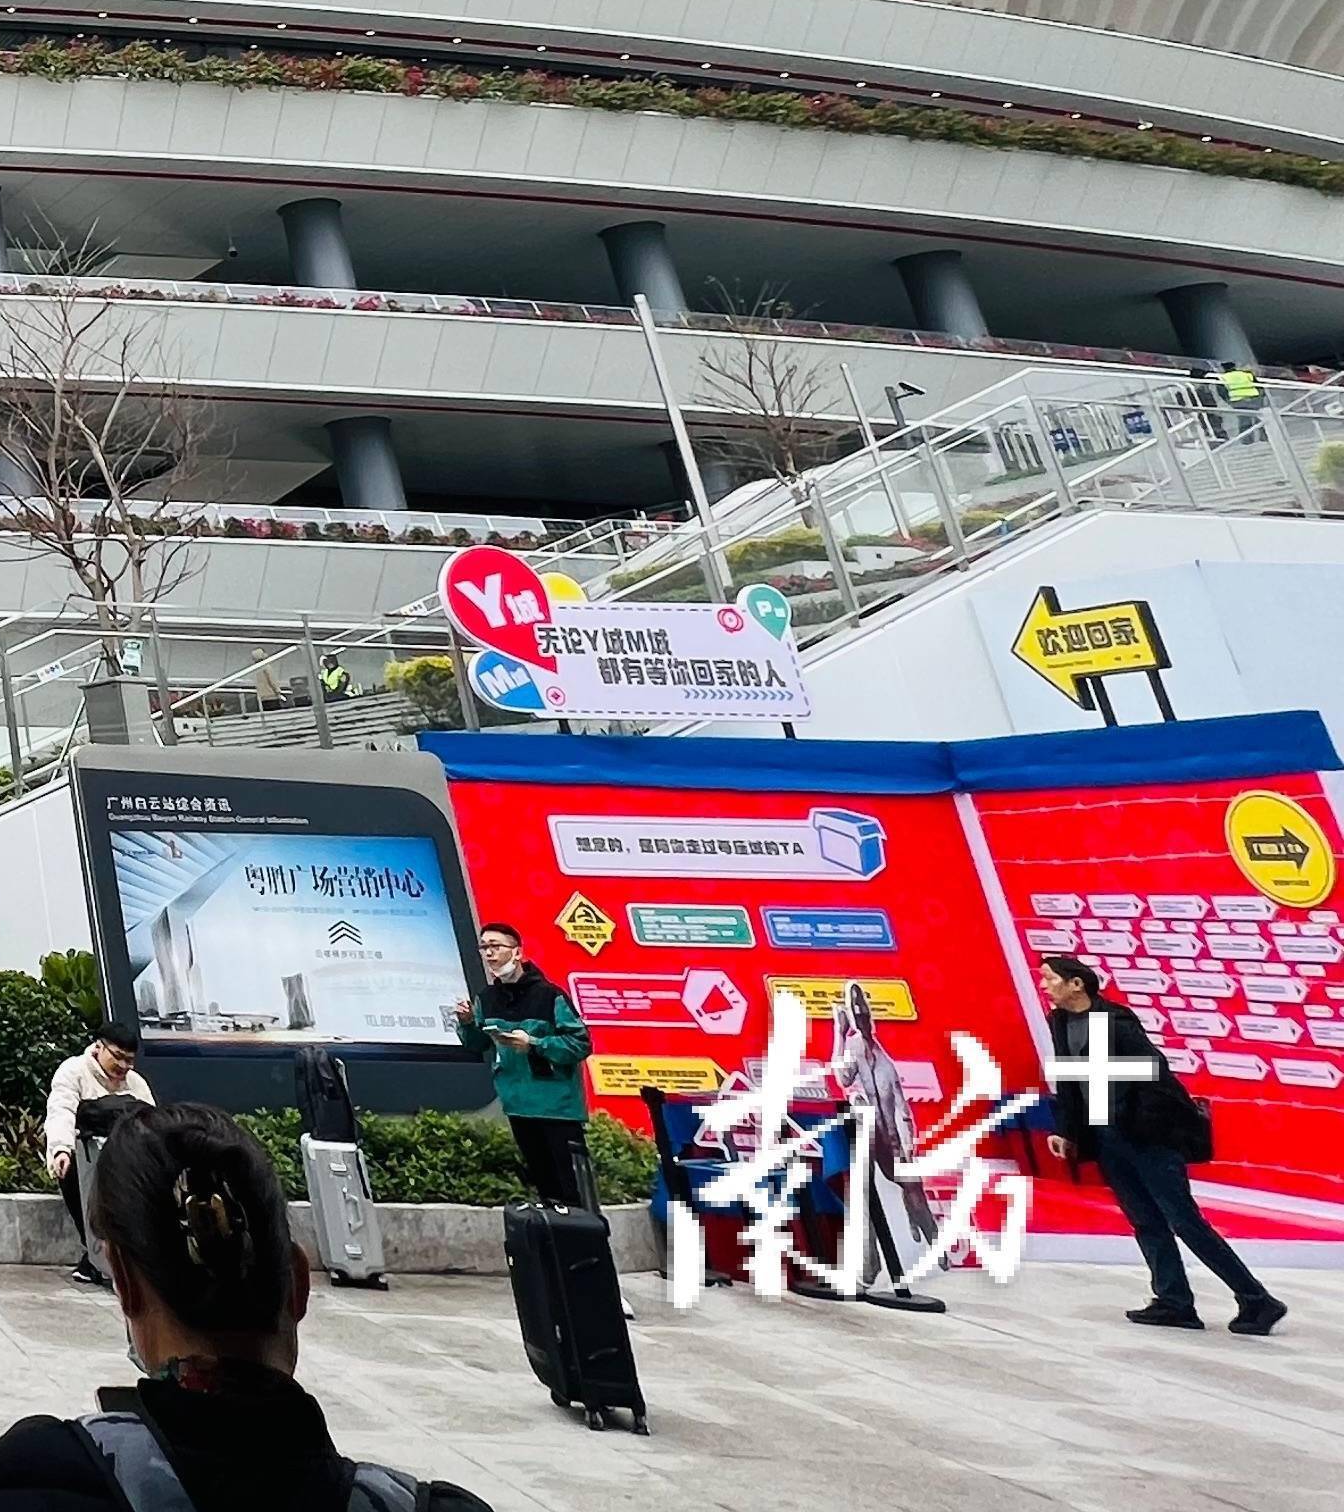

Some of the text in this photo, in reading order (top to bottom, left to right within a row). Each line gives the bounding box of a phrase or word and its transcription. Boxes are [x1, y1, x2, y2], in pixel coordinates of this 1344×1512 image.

[454, 573, 545, 629] Y城
[537, 626, 672, 657] 无论Y城M城
[1035, 617, 1140, 657] 欢迎回家
[597, 657, 787, 688] 都有等你回家的人
[106, 796, 232, 813] 广州白云站综合资讯
